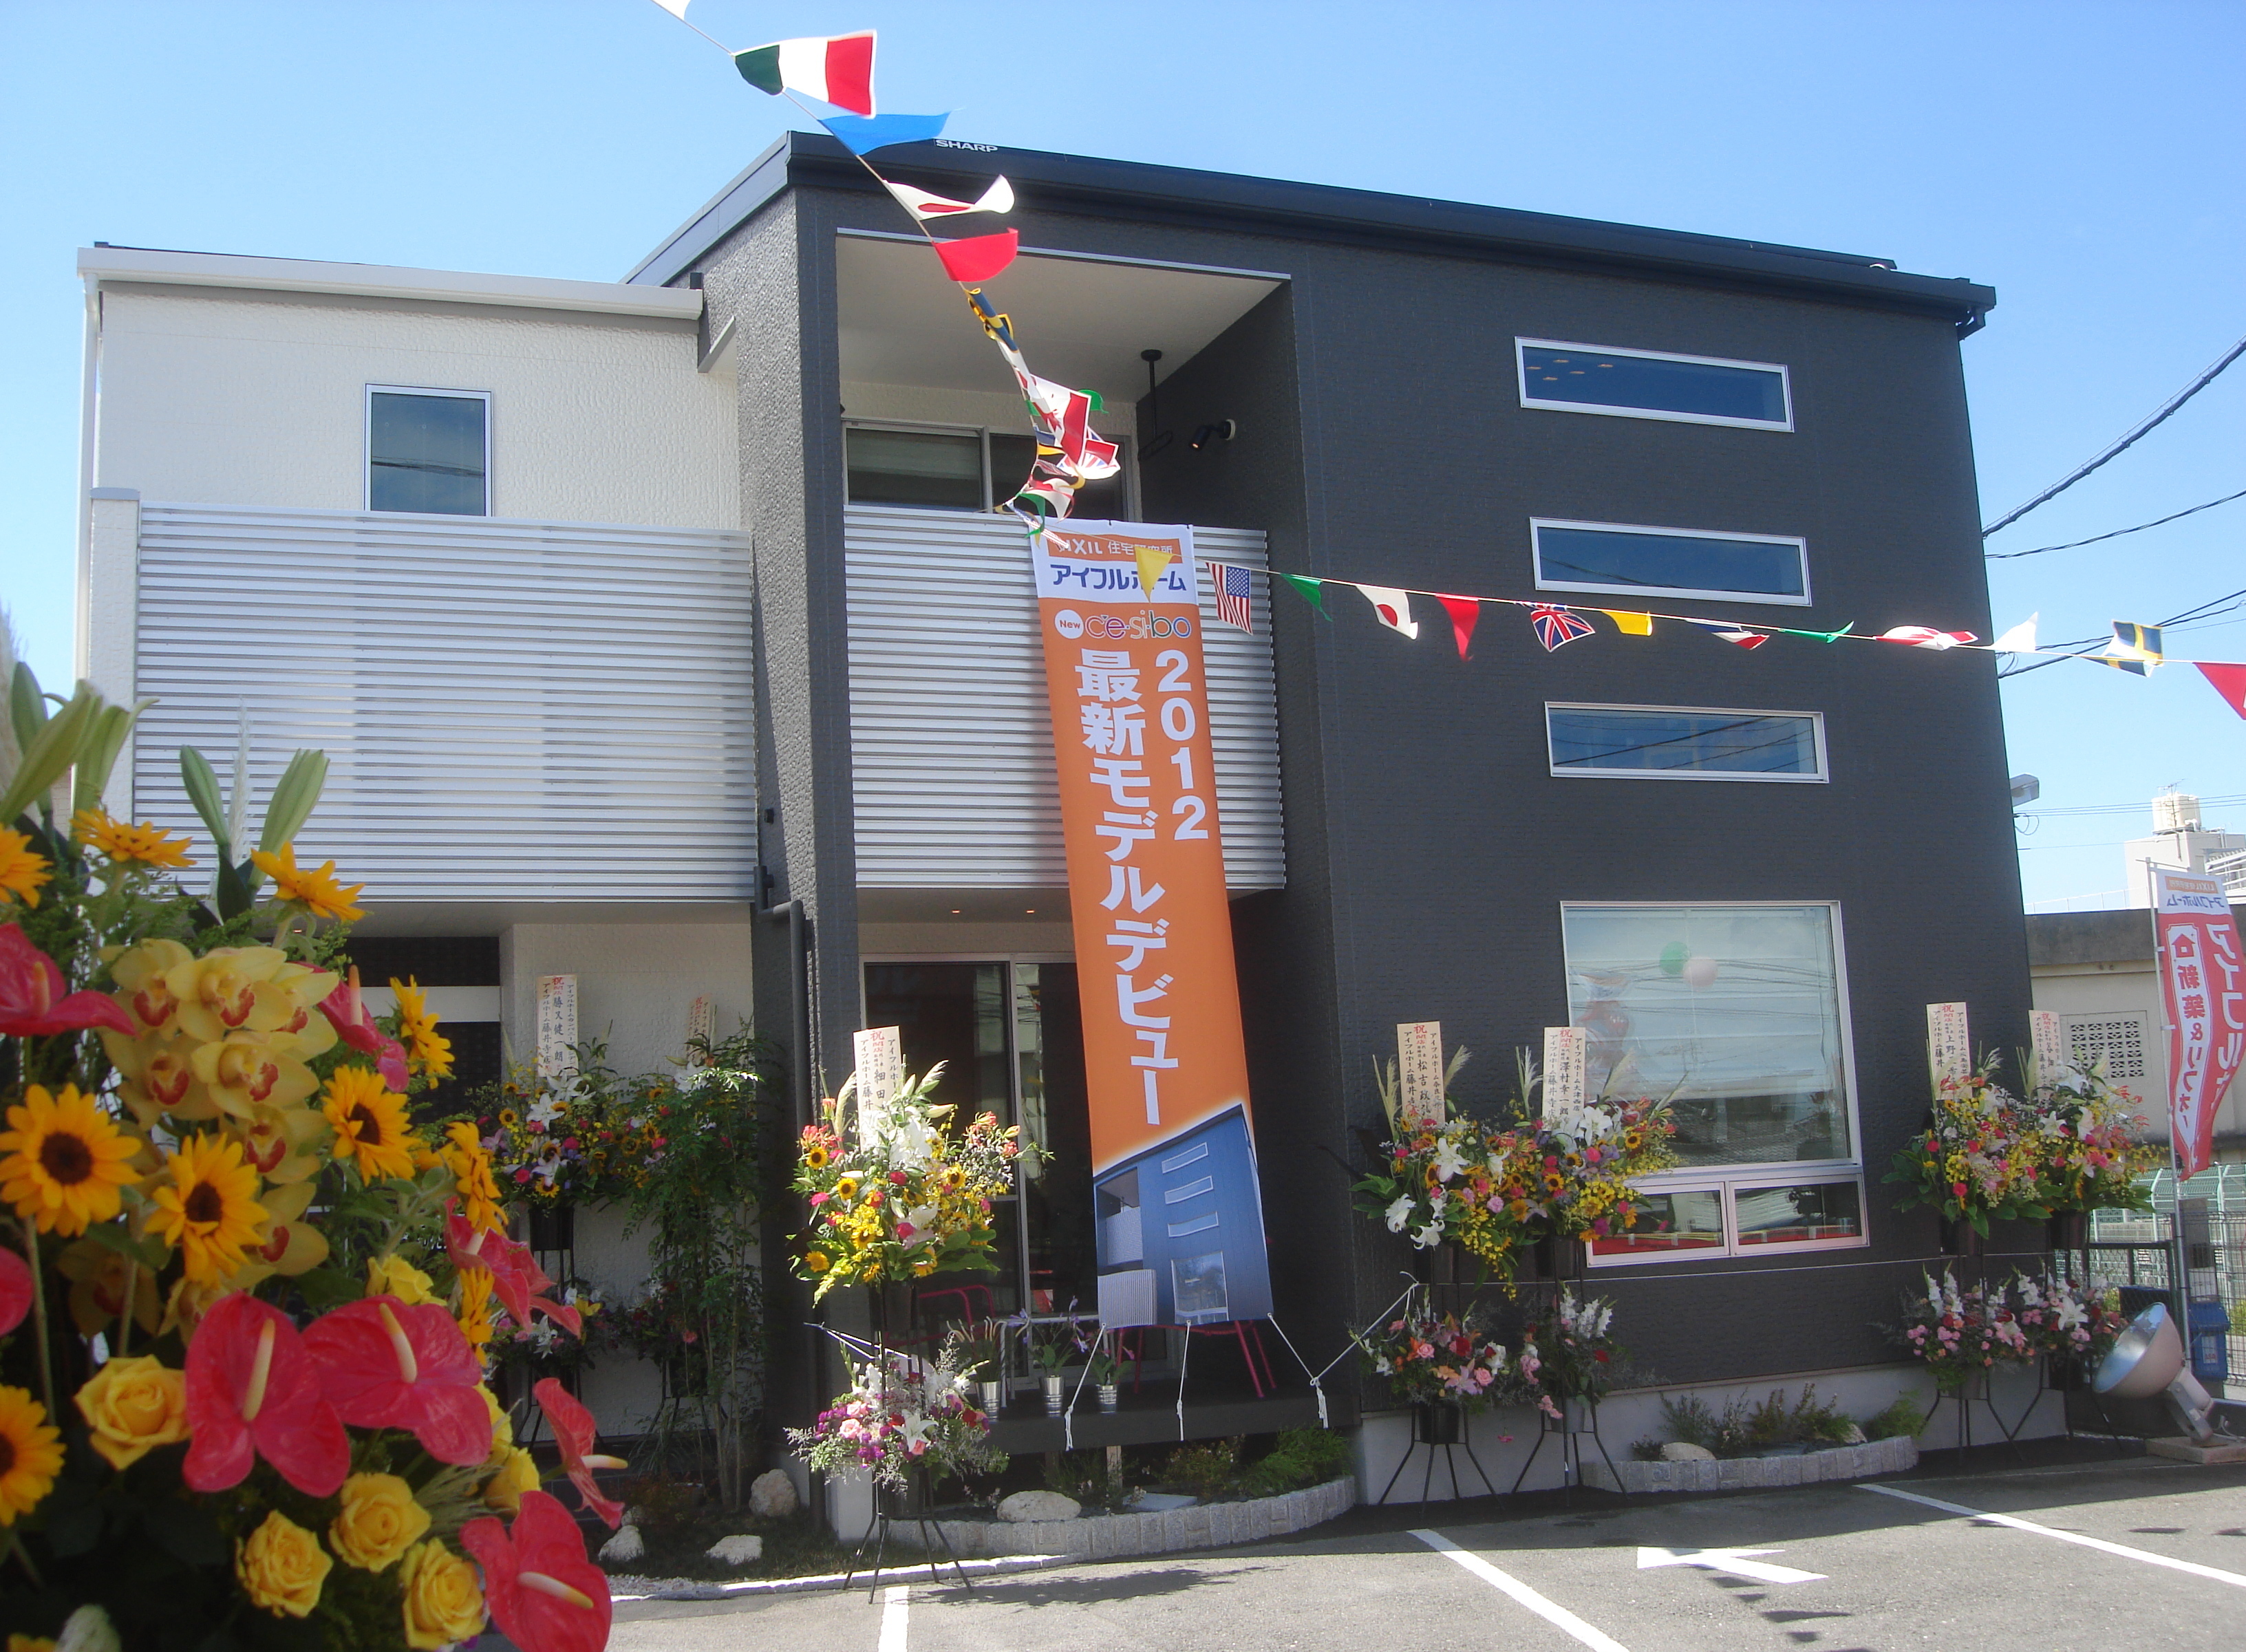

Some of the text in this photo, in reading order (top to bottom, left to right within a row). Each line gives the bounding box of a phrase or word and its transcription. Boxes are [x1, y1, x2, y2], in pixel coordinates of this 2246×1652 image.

[936, 139, 998, 153] SHARP
[1060, 619, 1081, 630] New
[1155, 649, 1209, 841] 2012
[1074, 647, 1179, 1125] 最新モデルデビュー
